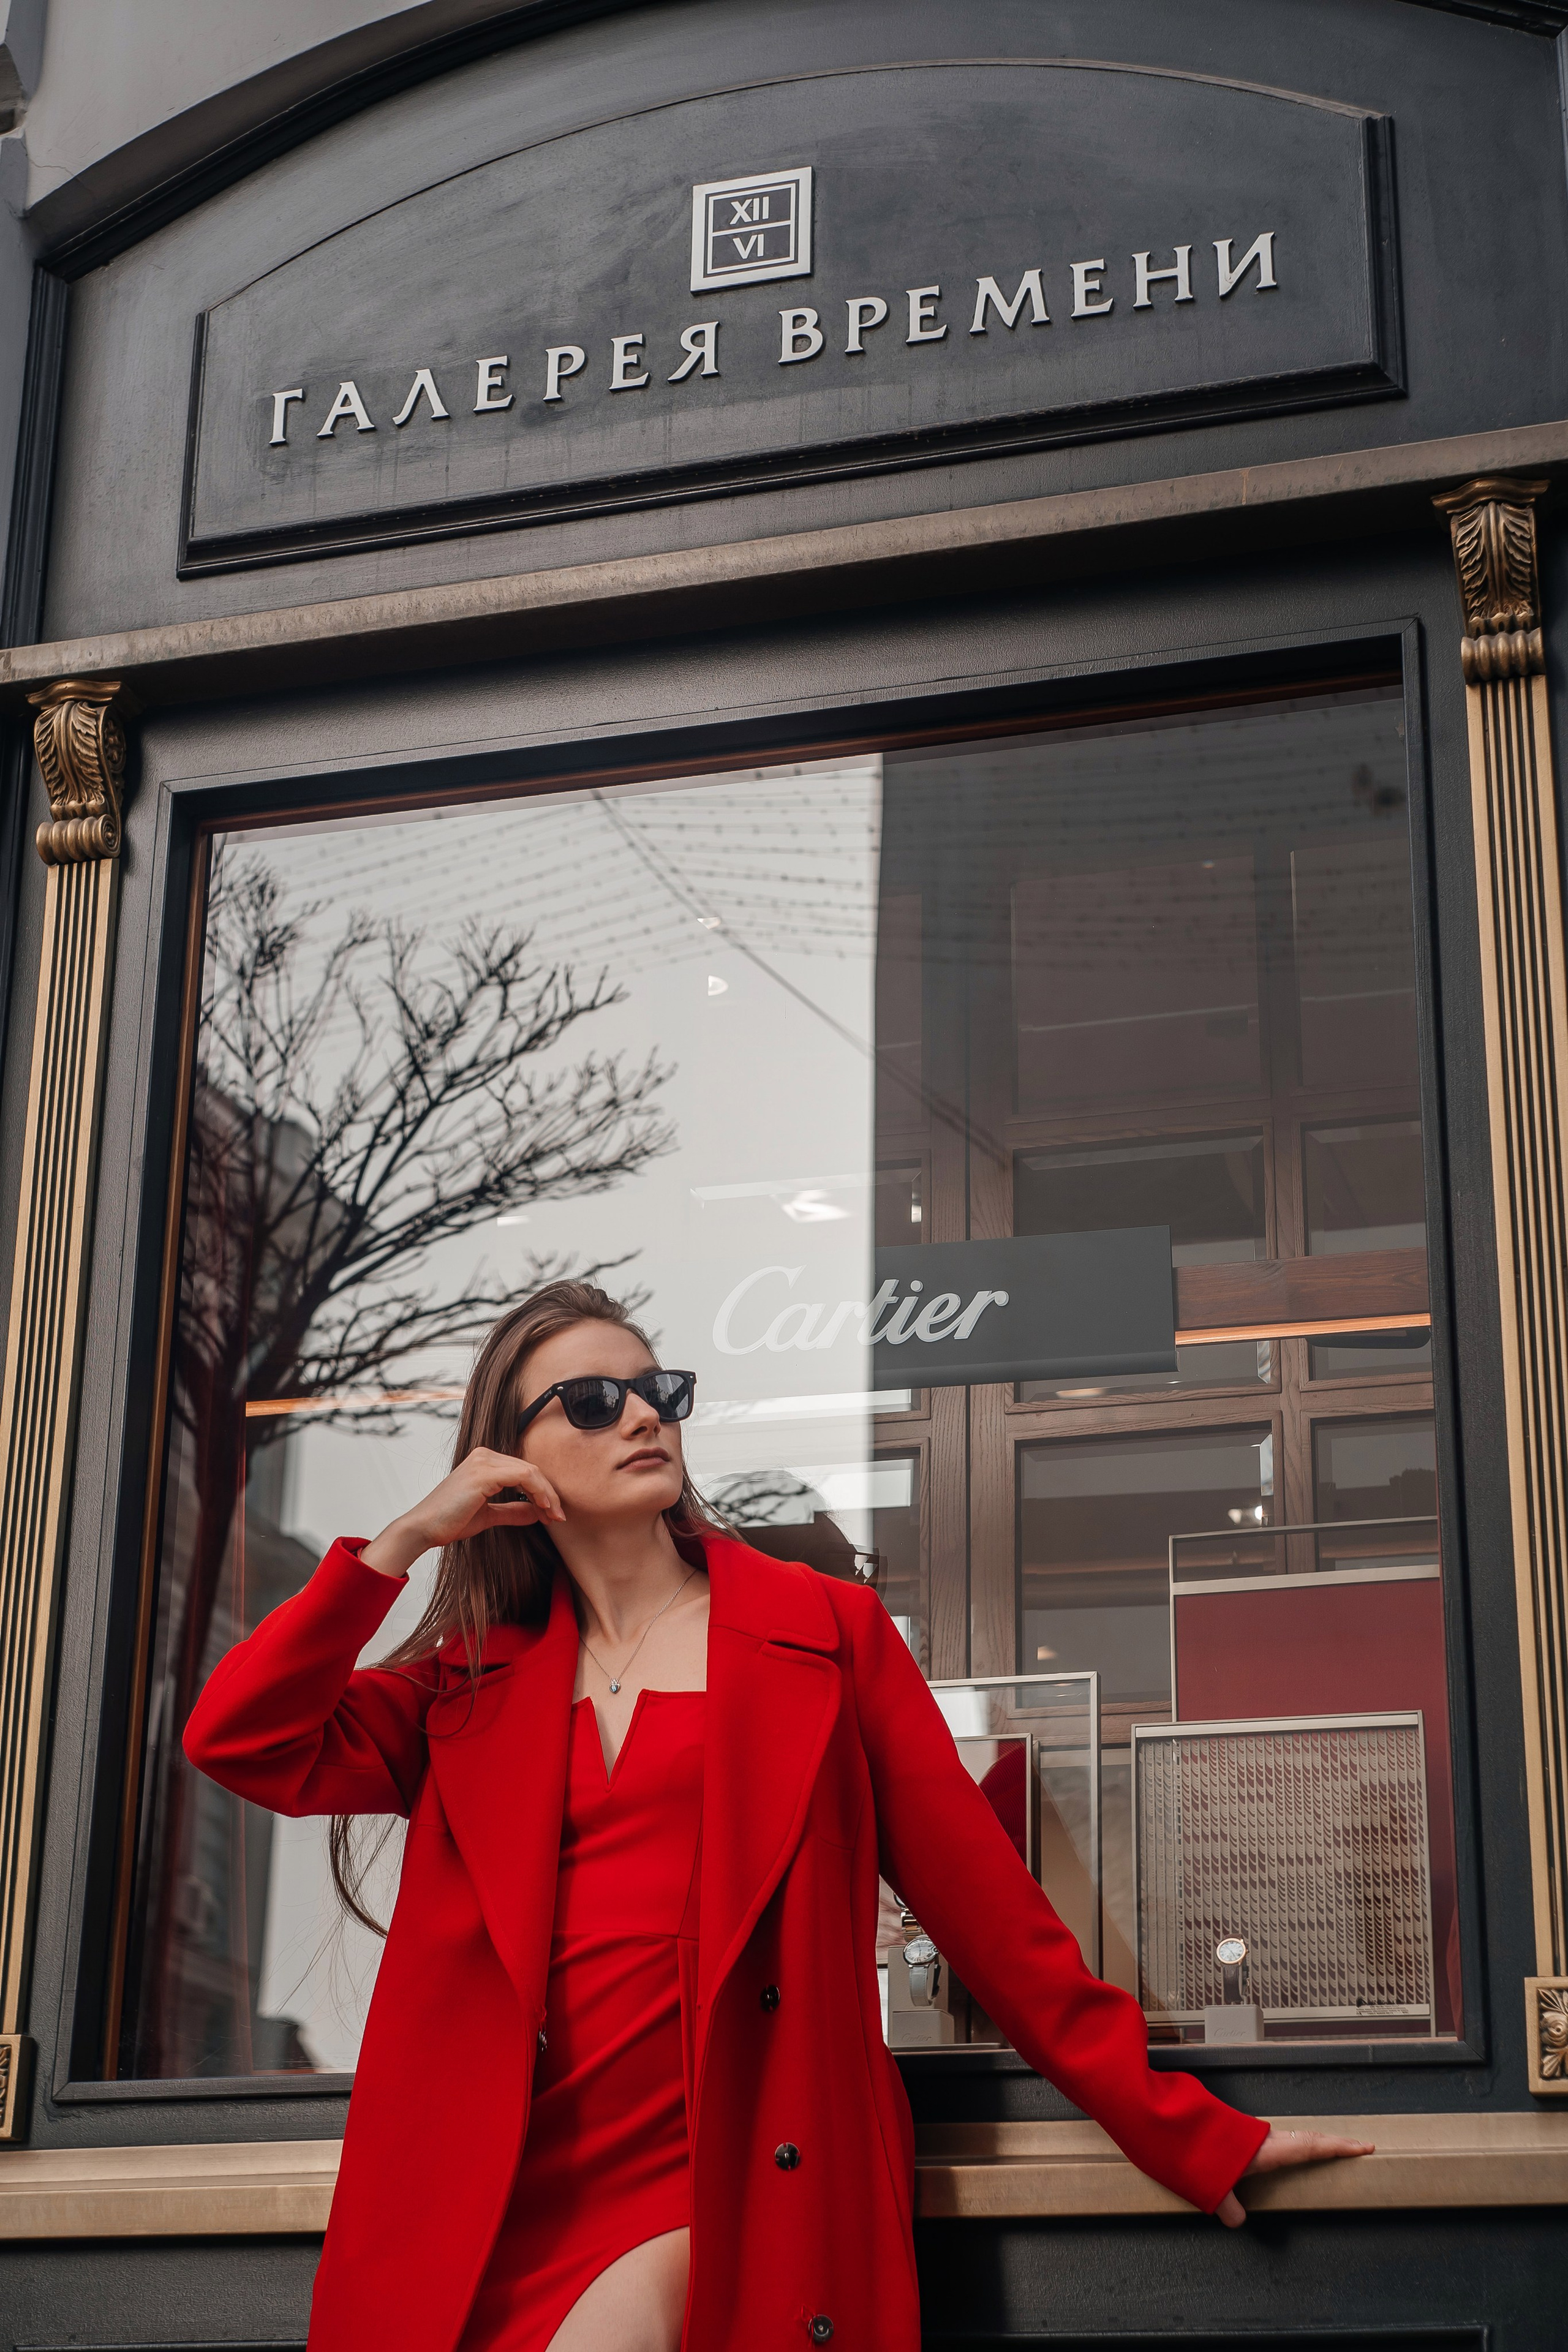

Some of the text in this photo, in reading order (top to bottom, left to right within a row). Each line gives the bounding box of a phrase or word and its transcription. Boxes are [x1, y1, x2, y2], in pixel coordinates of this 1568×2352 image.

[729, 196, 769, 225] XII
[732, 233, 764, 259] VI
[268, 231, 1278, 446] ГАЛЕРЕЯ ВРЕМЕНИ
[712, 1264, 1009, 1355] Cartier
